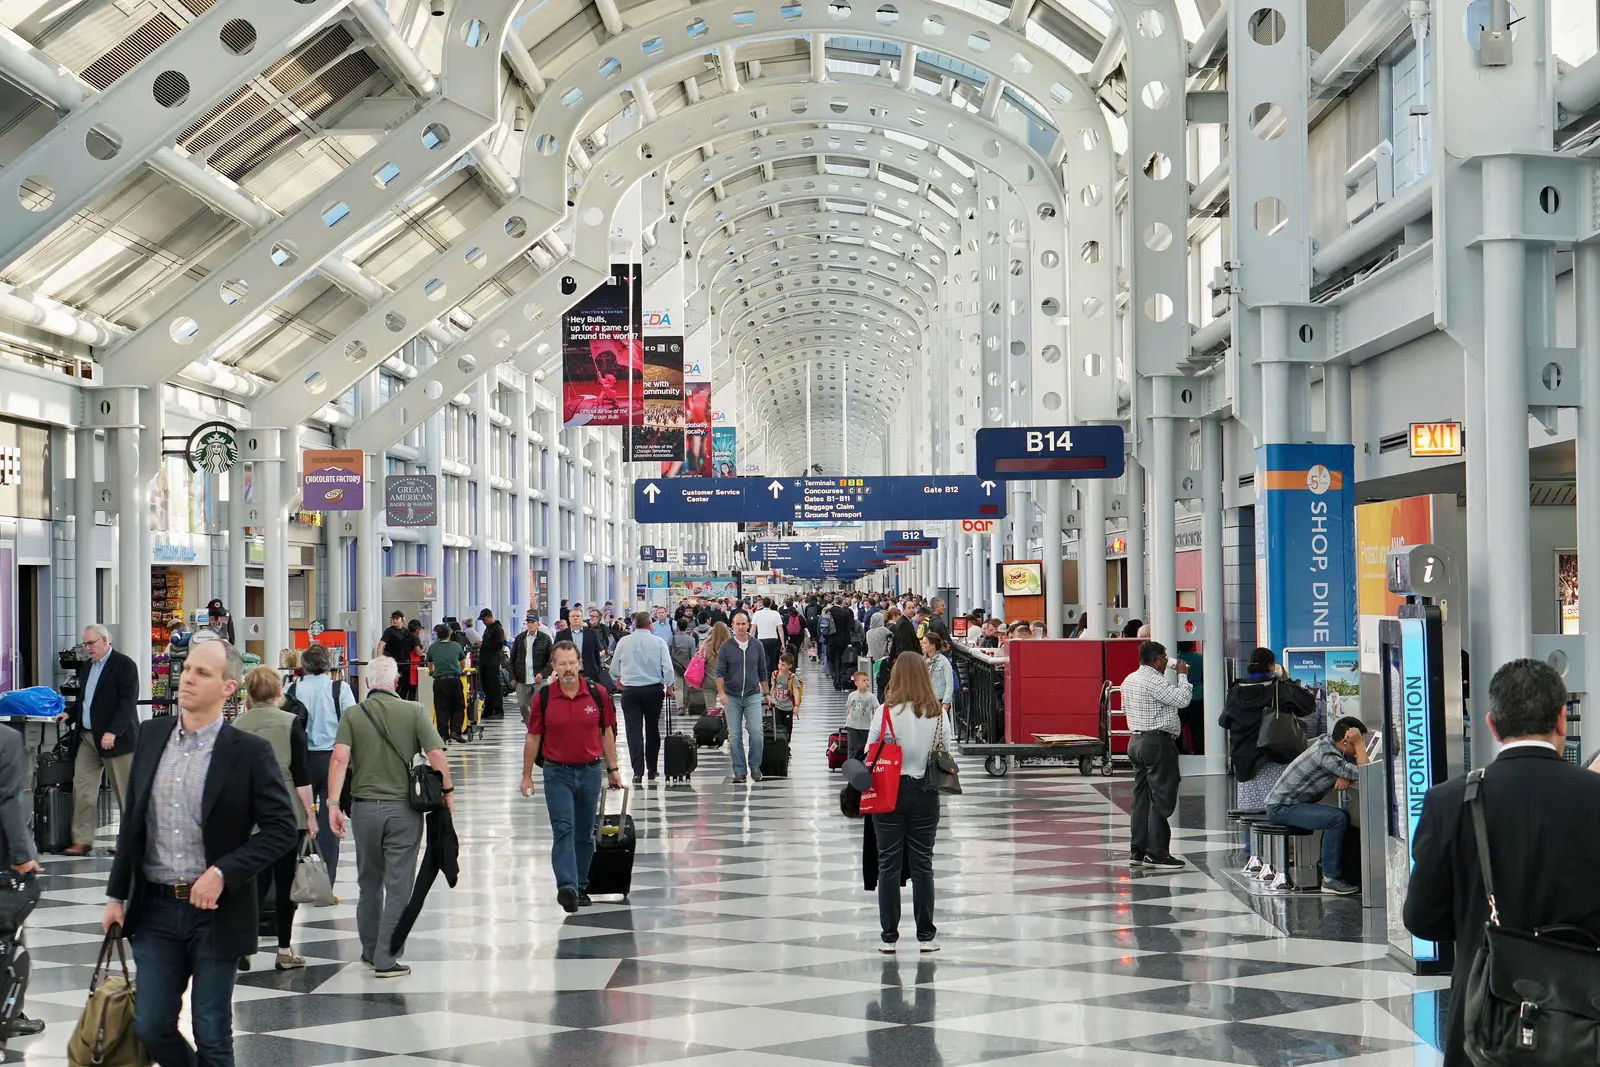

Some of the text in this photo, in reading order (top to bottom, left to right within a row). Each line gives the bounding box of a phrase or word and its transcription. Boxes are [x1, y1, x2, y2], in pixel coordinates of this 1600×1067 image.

[570, 316, 607, 324] Hey Bulls,
[684, 364, 700, 374] DA
[1026, 430, 1073, 452] B14
[1414, 424, 1456, 448] EXIT
[305, 475, 360, 484] CHOCOLATE FACTORY
[962, 520, 993, 531] bar
[1310, 501, 1329, 642] SHOP, DINE
[1406, 676, 1425, 817] INFORMATION
